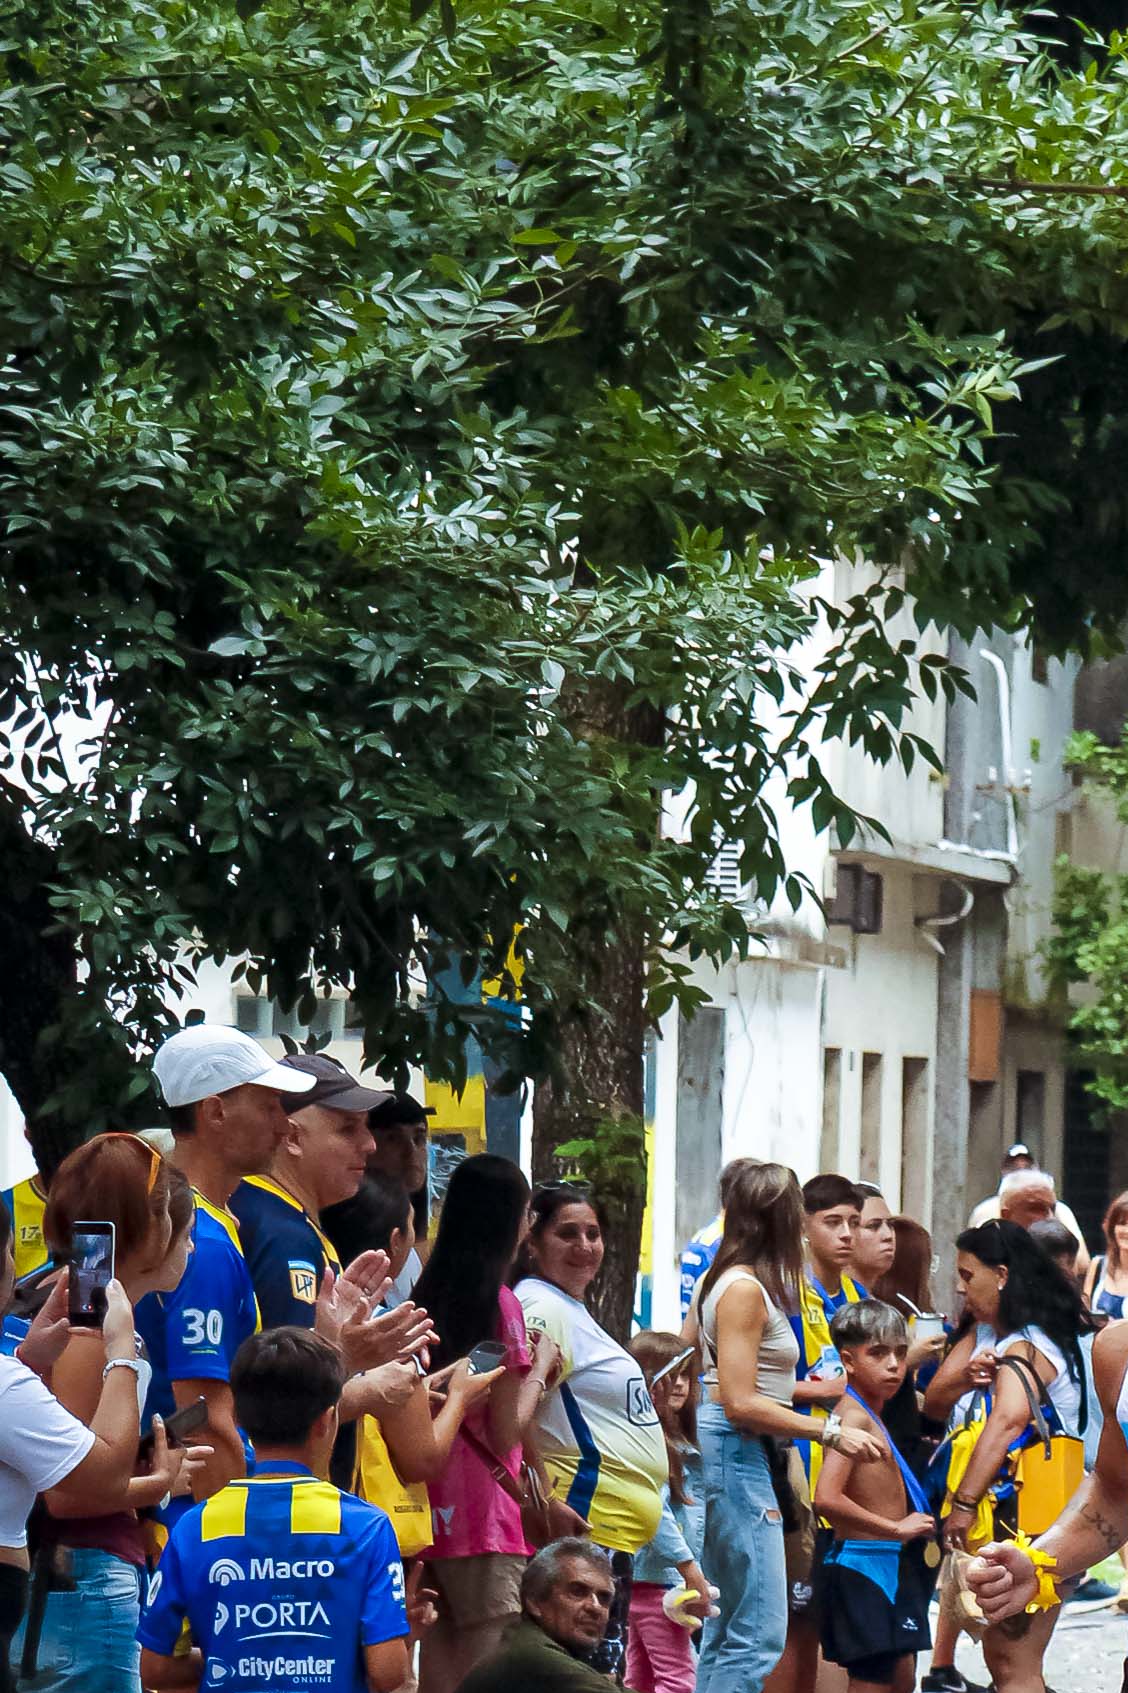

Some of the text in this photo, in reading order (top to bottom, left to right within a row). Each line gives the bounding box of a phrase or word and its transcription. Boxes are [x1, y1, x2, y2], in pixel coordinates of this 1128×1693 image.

[182, 1308, 223, 1345] 30
[249, 1557, 335, 1580] Macro
[235, 1601, 332, 1628] PORTA
[238, 1655, 336, 1681] CityCenter
[292, 1675, 332, 1684] ONLINE
